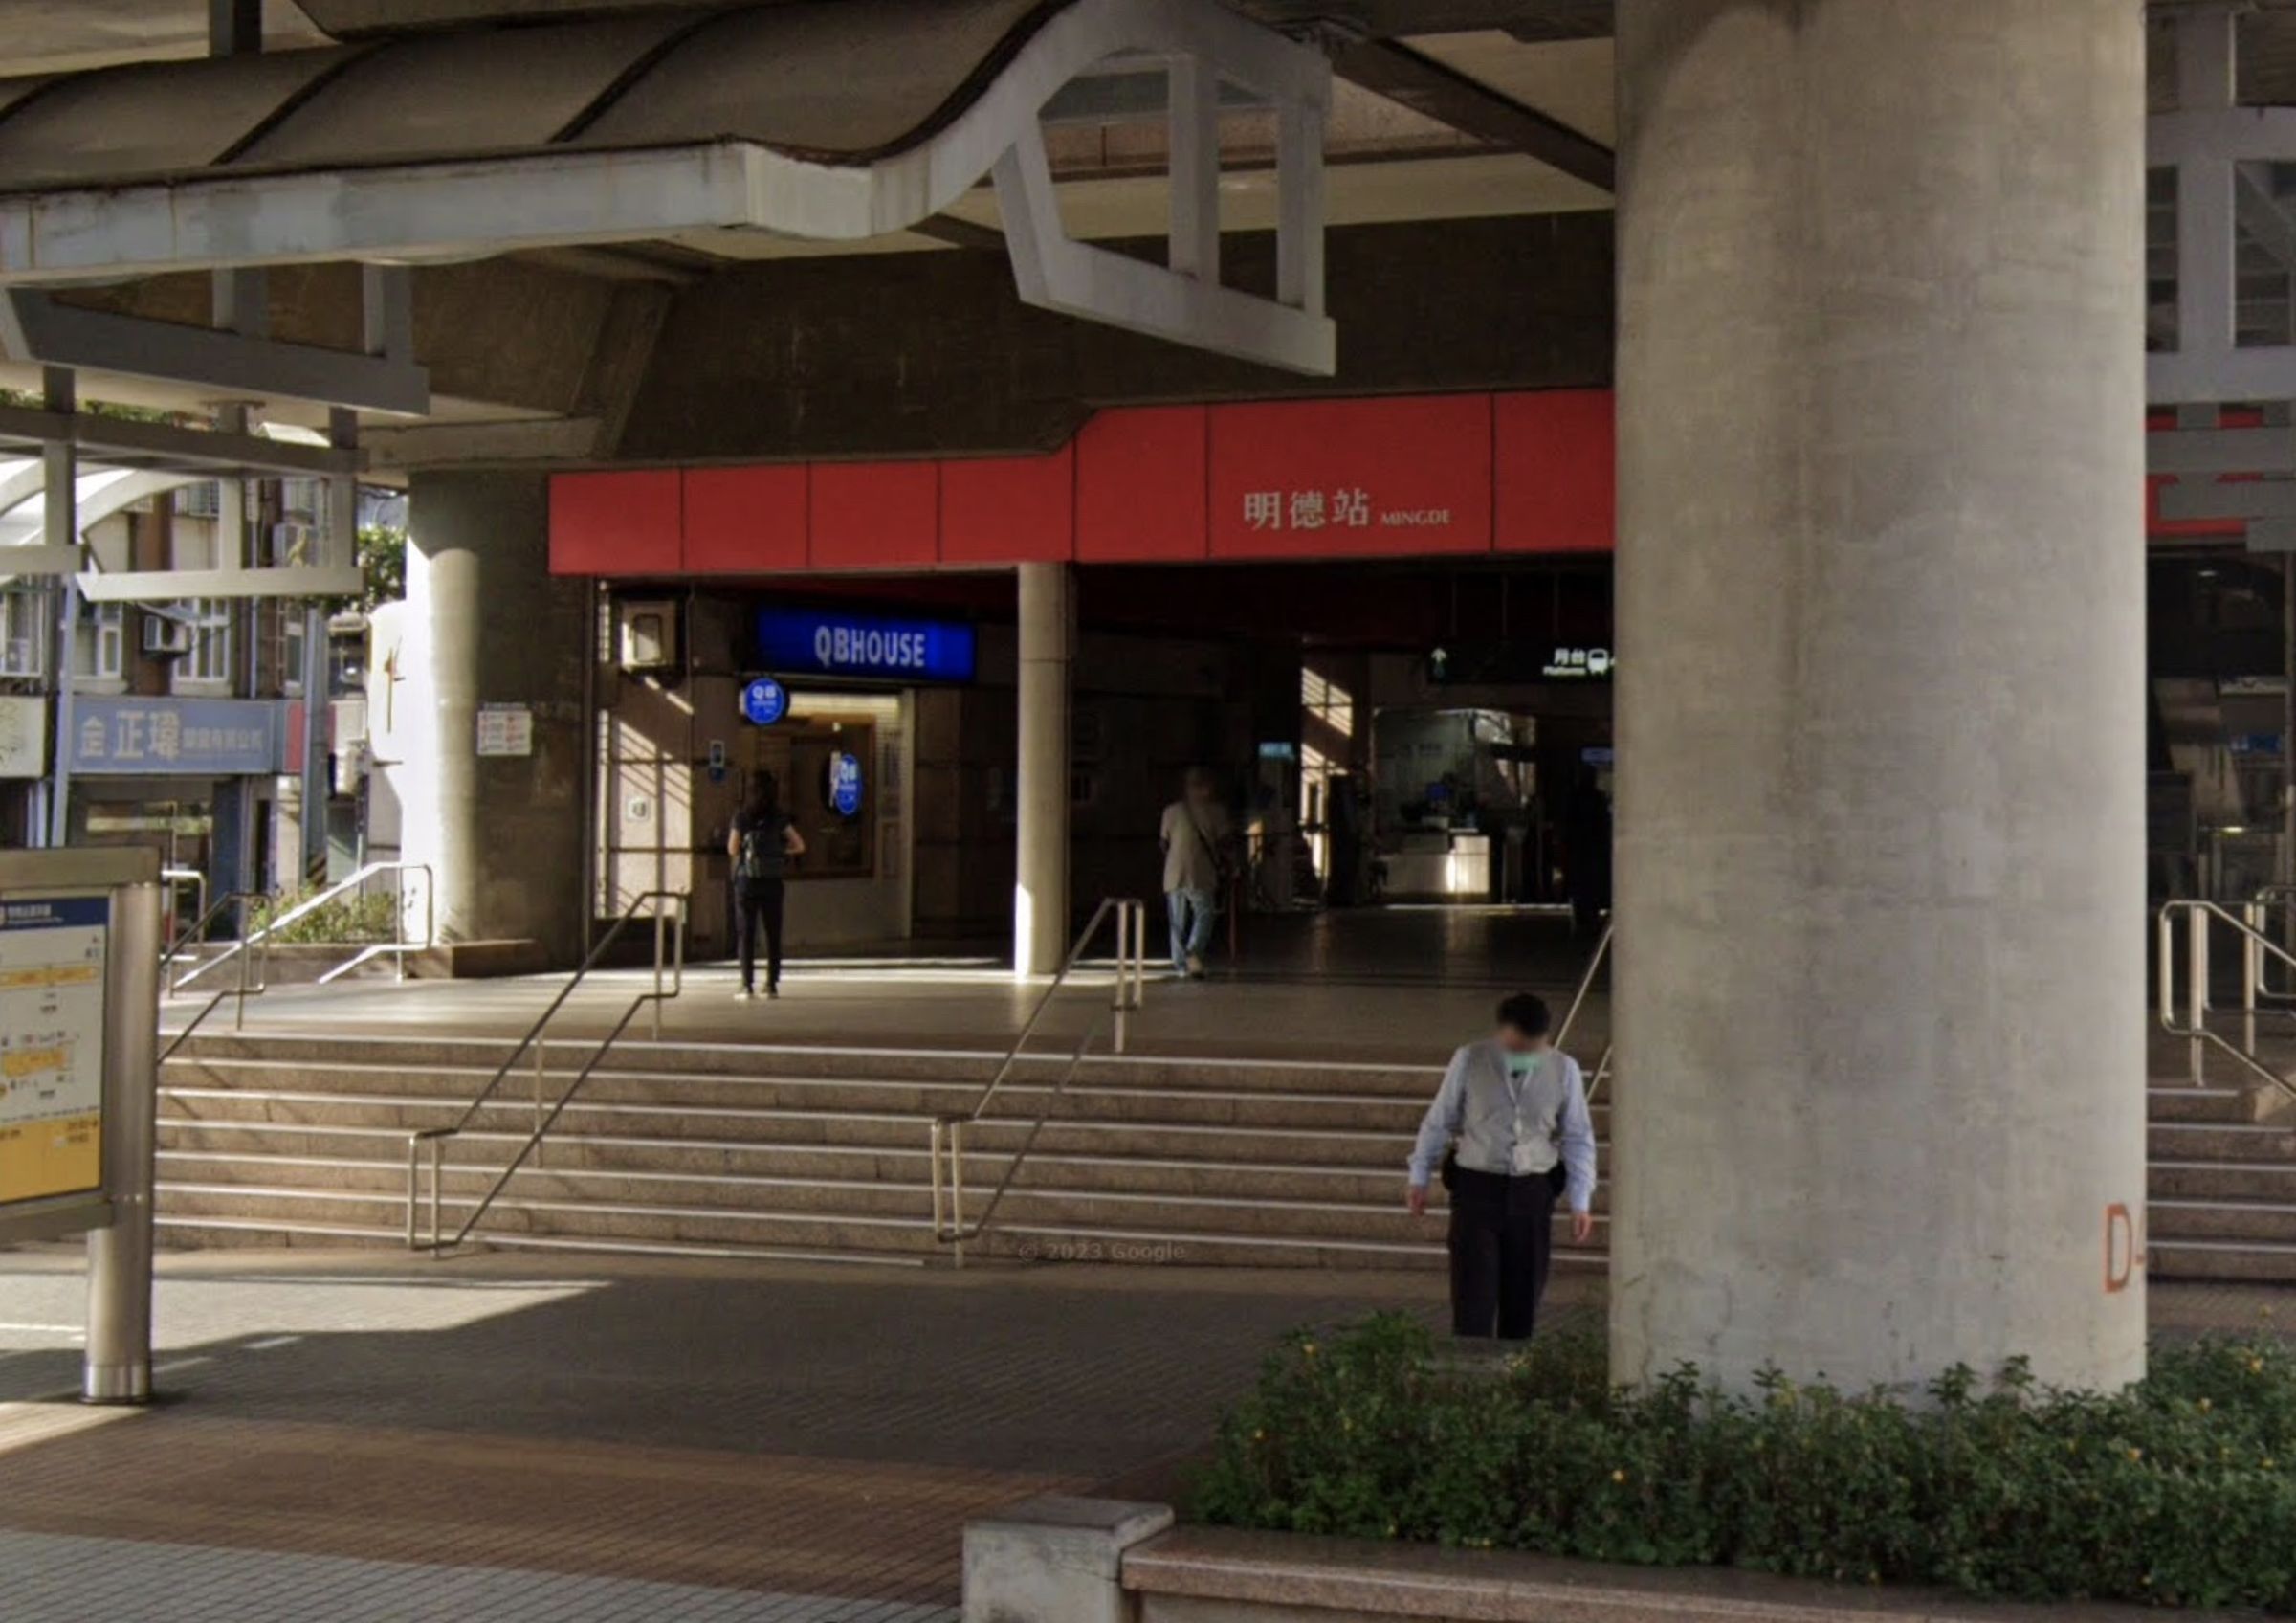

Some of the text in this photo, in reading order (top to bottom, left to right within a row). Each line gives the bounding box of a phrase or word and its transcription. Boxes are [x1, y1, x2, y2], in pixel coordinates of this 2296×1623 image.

[1244, 488, 1451, 530] 明德站 MINGDE
[752, 685, 777, 700] QB
